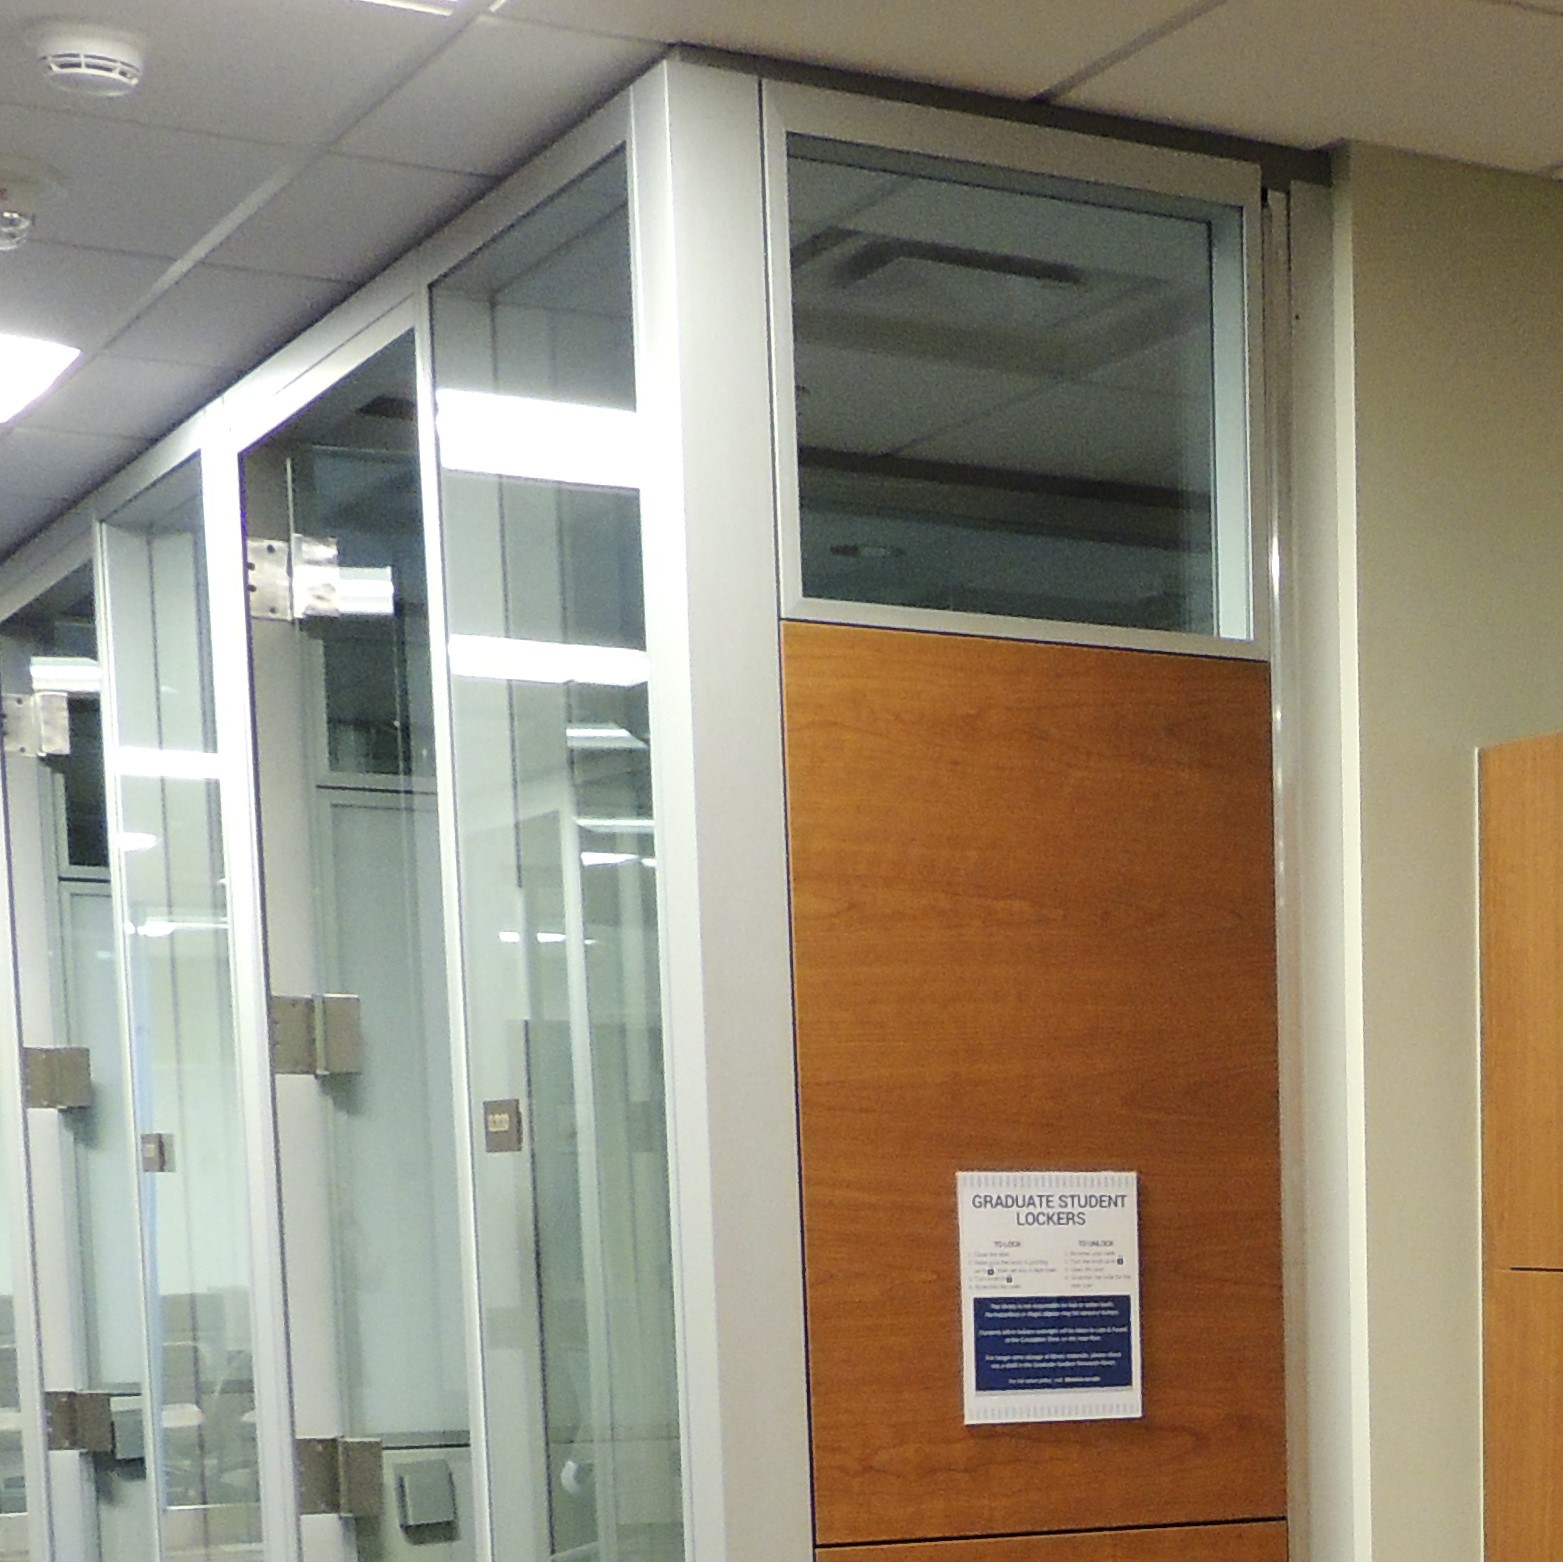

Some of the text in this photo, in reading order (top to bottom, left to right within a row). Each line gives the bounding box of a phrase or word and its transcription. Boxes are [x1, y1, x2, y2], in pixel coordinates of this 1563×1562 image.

[971, 1194, 1128, 1209] GRADUATE STUDENT
[1016, 1211, 1087, 1226] LOCKERS
